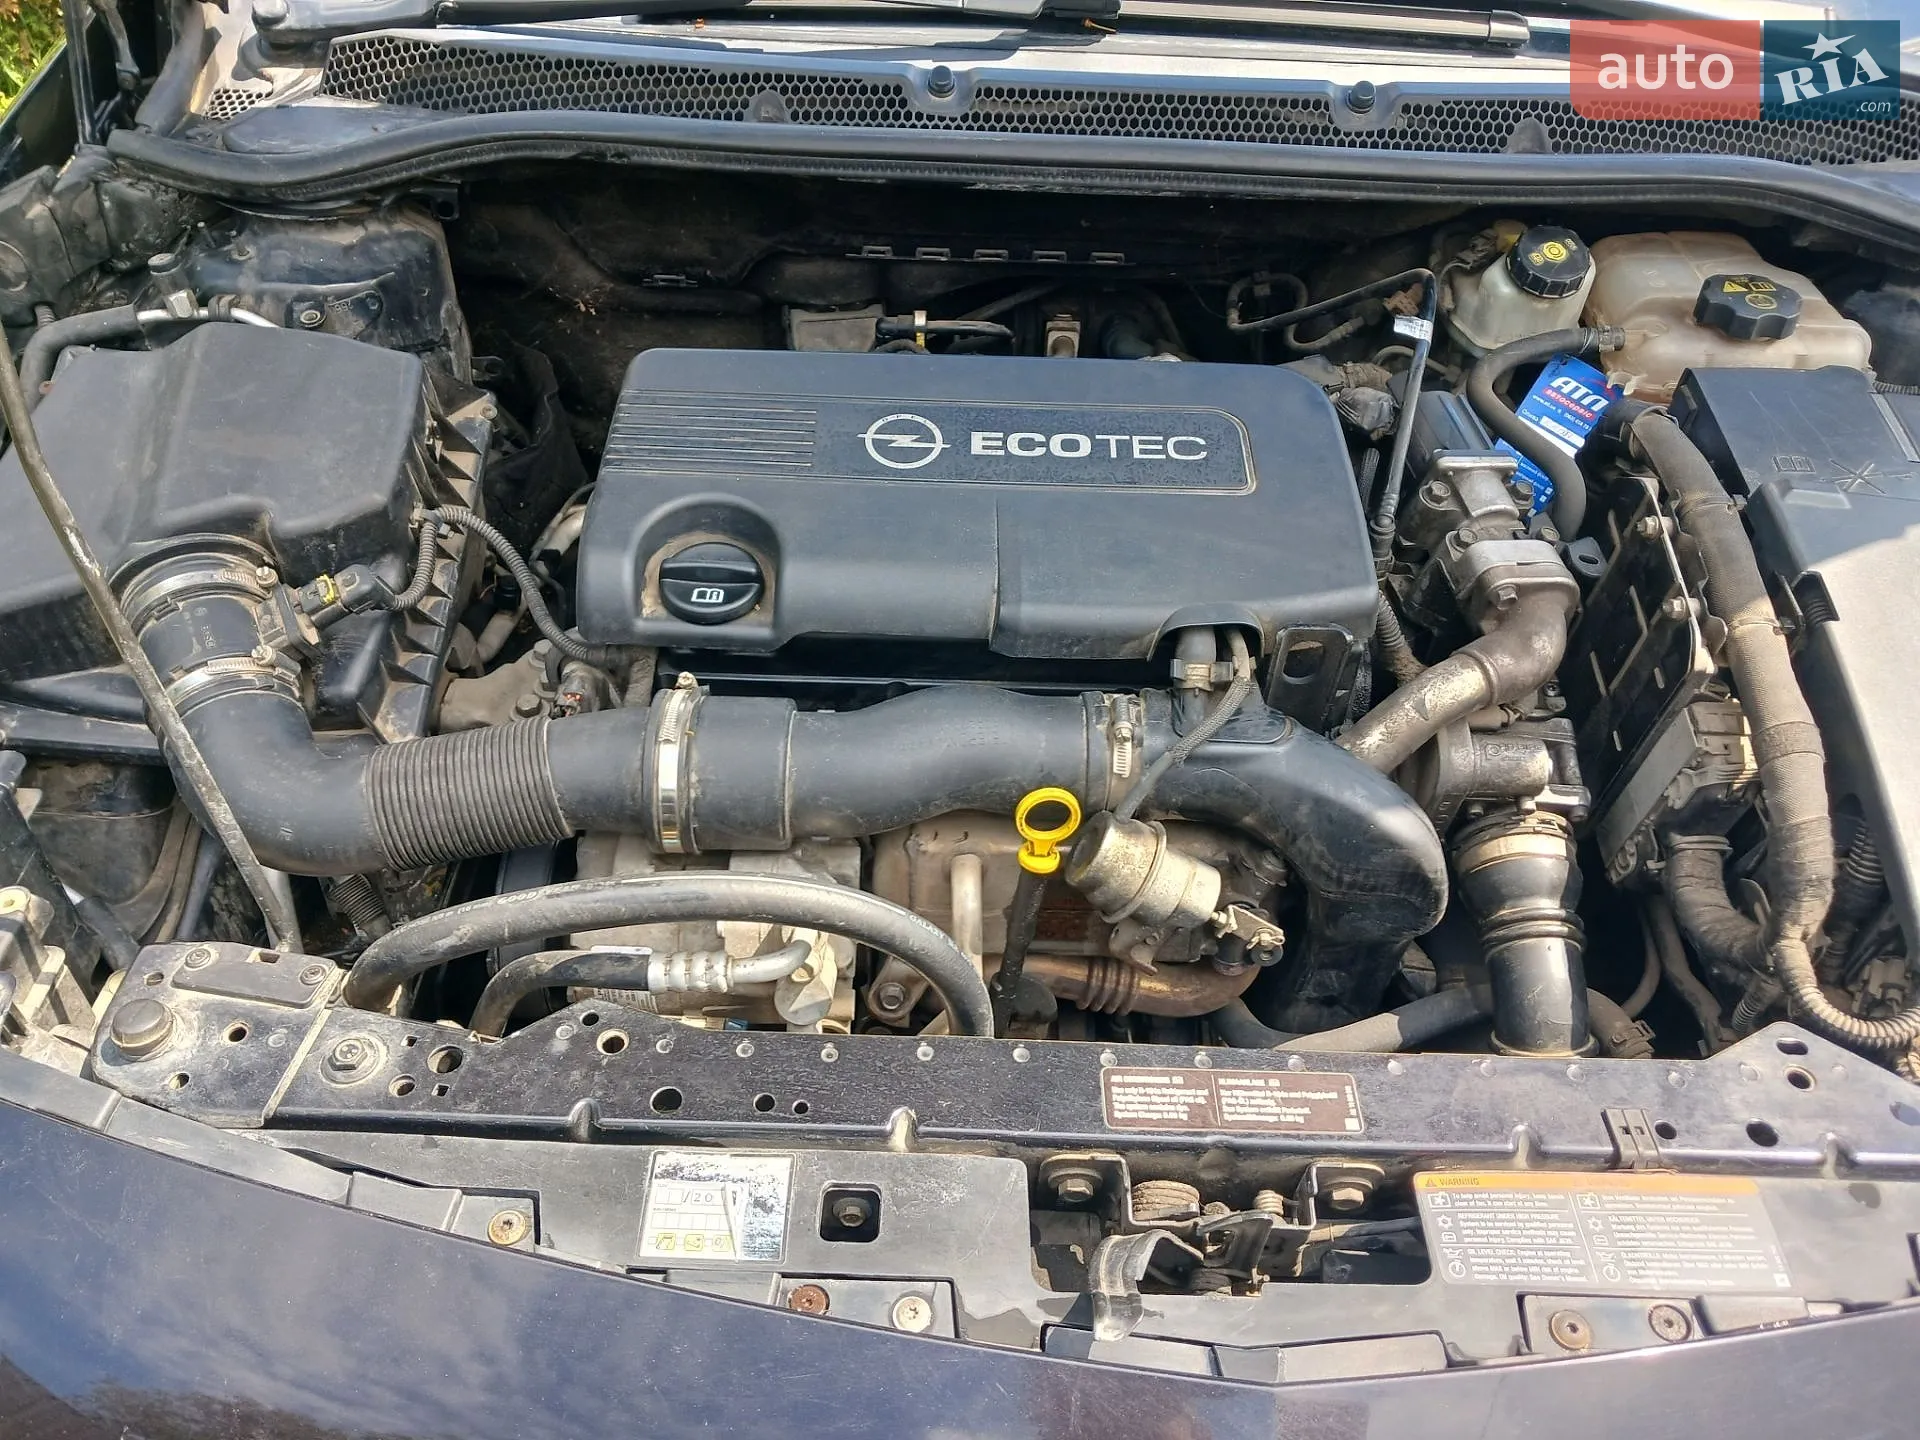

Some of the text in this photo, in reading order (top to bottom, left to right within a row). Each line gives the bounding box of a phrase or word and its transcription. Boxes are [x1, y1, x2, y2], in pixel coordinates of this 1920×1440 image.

[970, 431, 1208, 461] ECOTEC
[909, 914, 945, 939] GALAXY
[1440, 1178, 1479, 1187] WARNING
